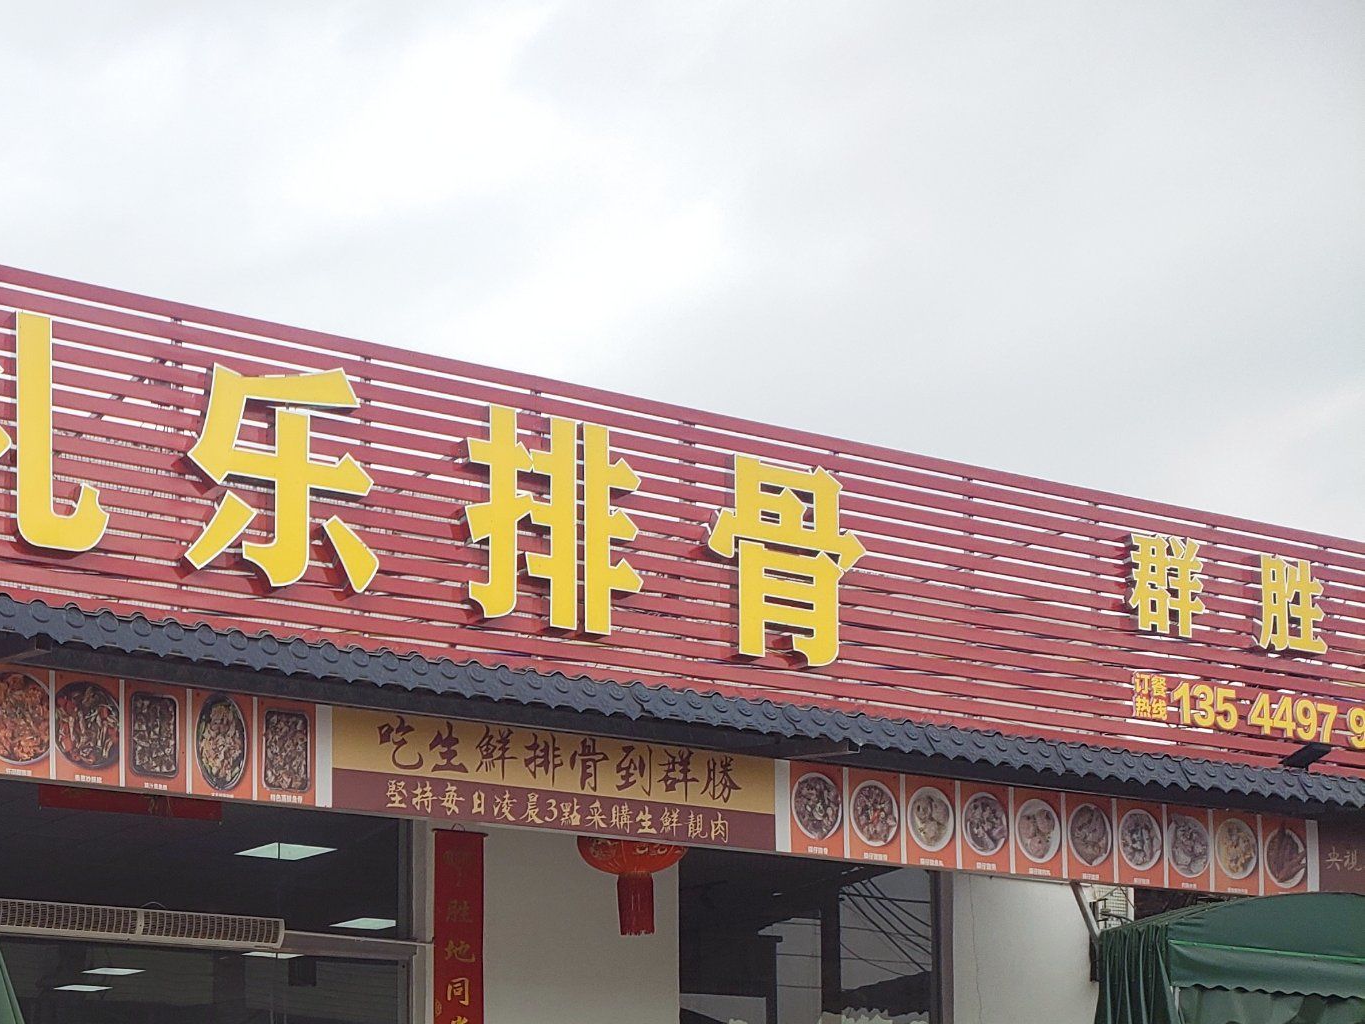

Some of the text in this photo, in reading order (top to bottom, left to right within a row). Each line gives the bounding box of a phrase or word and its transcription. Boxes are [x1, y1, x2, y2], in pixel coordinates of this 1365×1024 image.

[1129, 533, 1328, 654] 群胜
[1171, 681, 1238, 730] 135
[1247, 691, 1338, 744] 4497
[377, 715, 742, 804] 吃生鮮排骨到群勝
